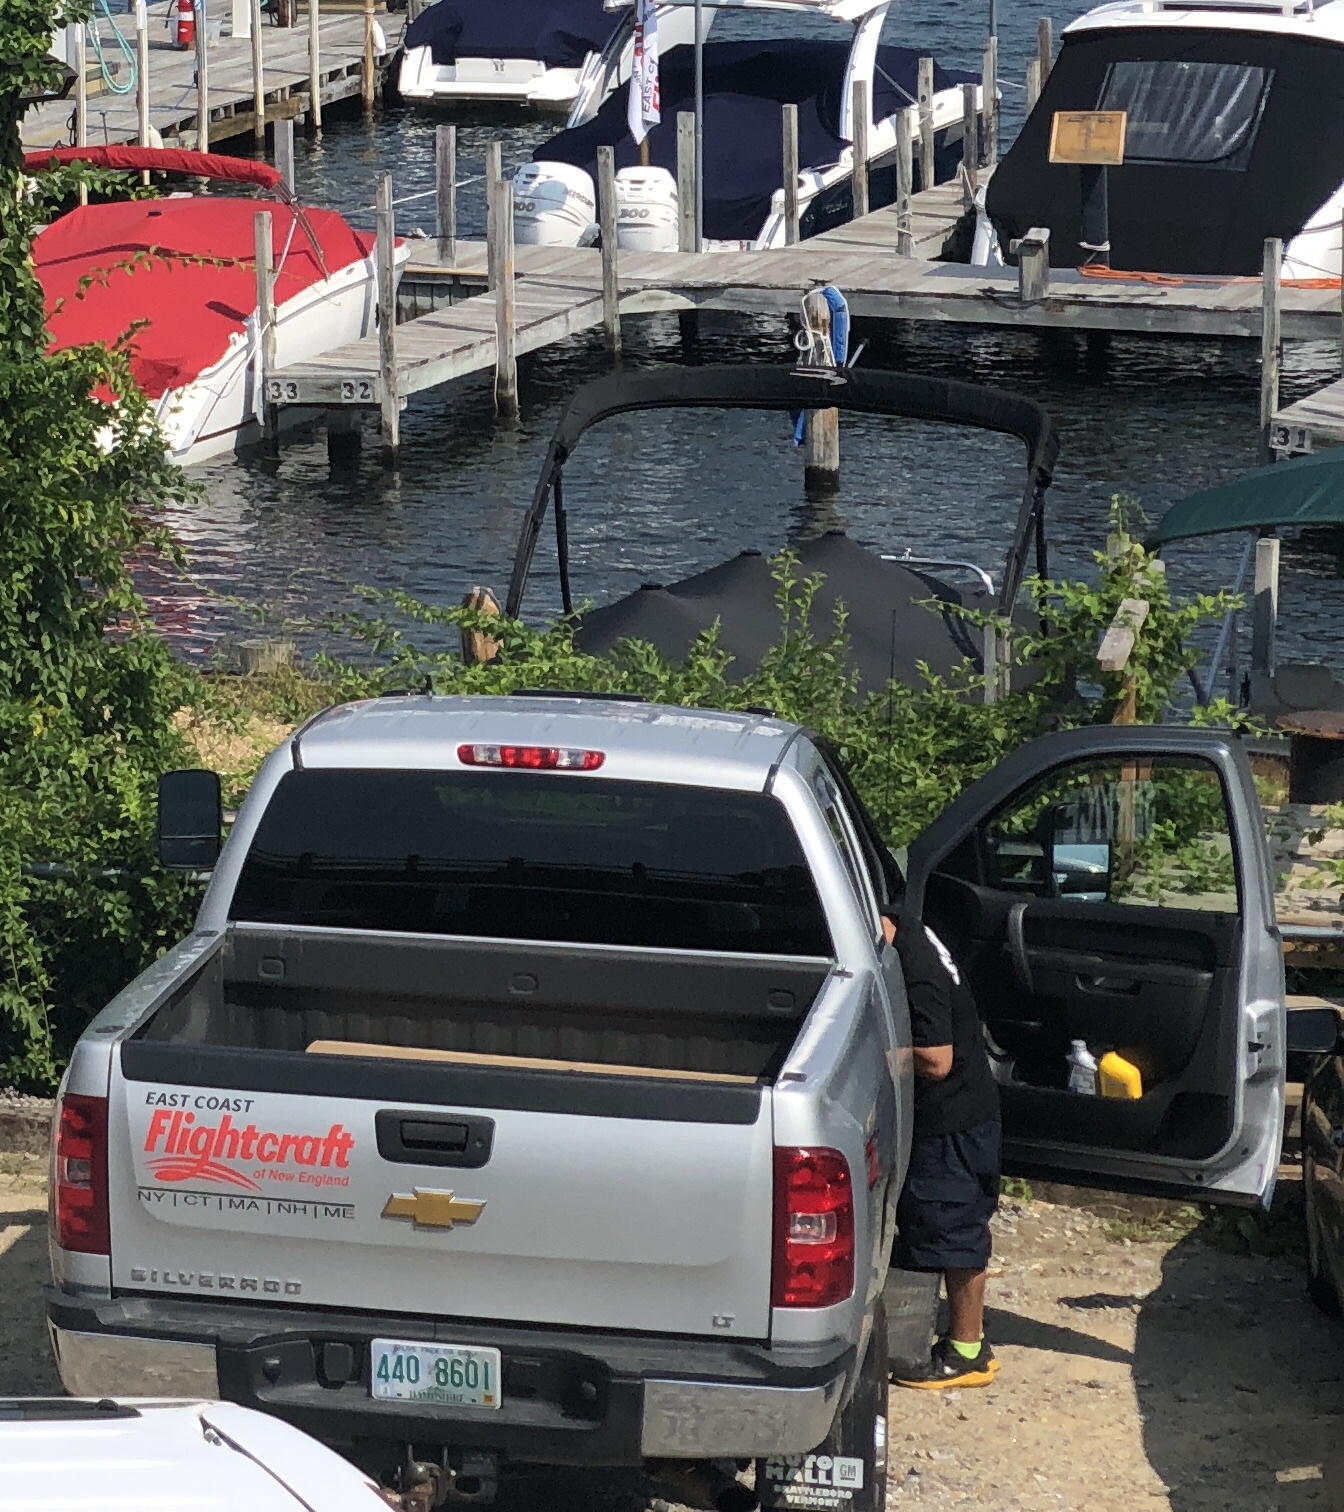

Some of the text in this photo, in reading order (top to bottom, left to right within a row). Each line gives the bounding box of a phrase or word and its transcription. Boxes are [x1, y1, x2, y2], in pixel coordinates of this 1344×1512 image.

[271, 381, 298, 400] 33
[342, 381, 371, 400] 32
[1276, 426, 1307, 449] 31
[145, 1091, 255, 1113] EAST COAST
[144, 1109, 355, 1175] Flightcraft
[252, 1168, 350, 1188] of New England
[137, 1190, 356, 1220] NY CT MA NH ME
[130, 1267, 303, 1296] SILVERADO
[712, 1313, 736, 1329] LT
[376, 1353, 491, 1391] 440 8601
[839, 1464, 858, 1478] GM
[786, 1494, 841, 1508] VERMONT
